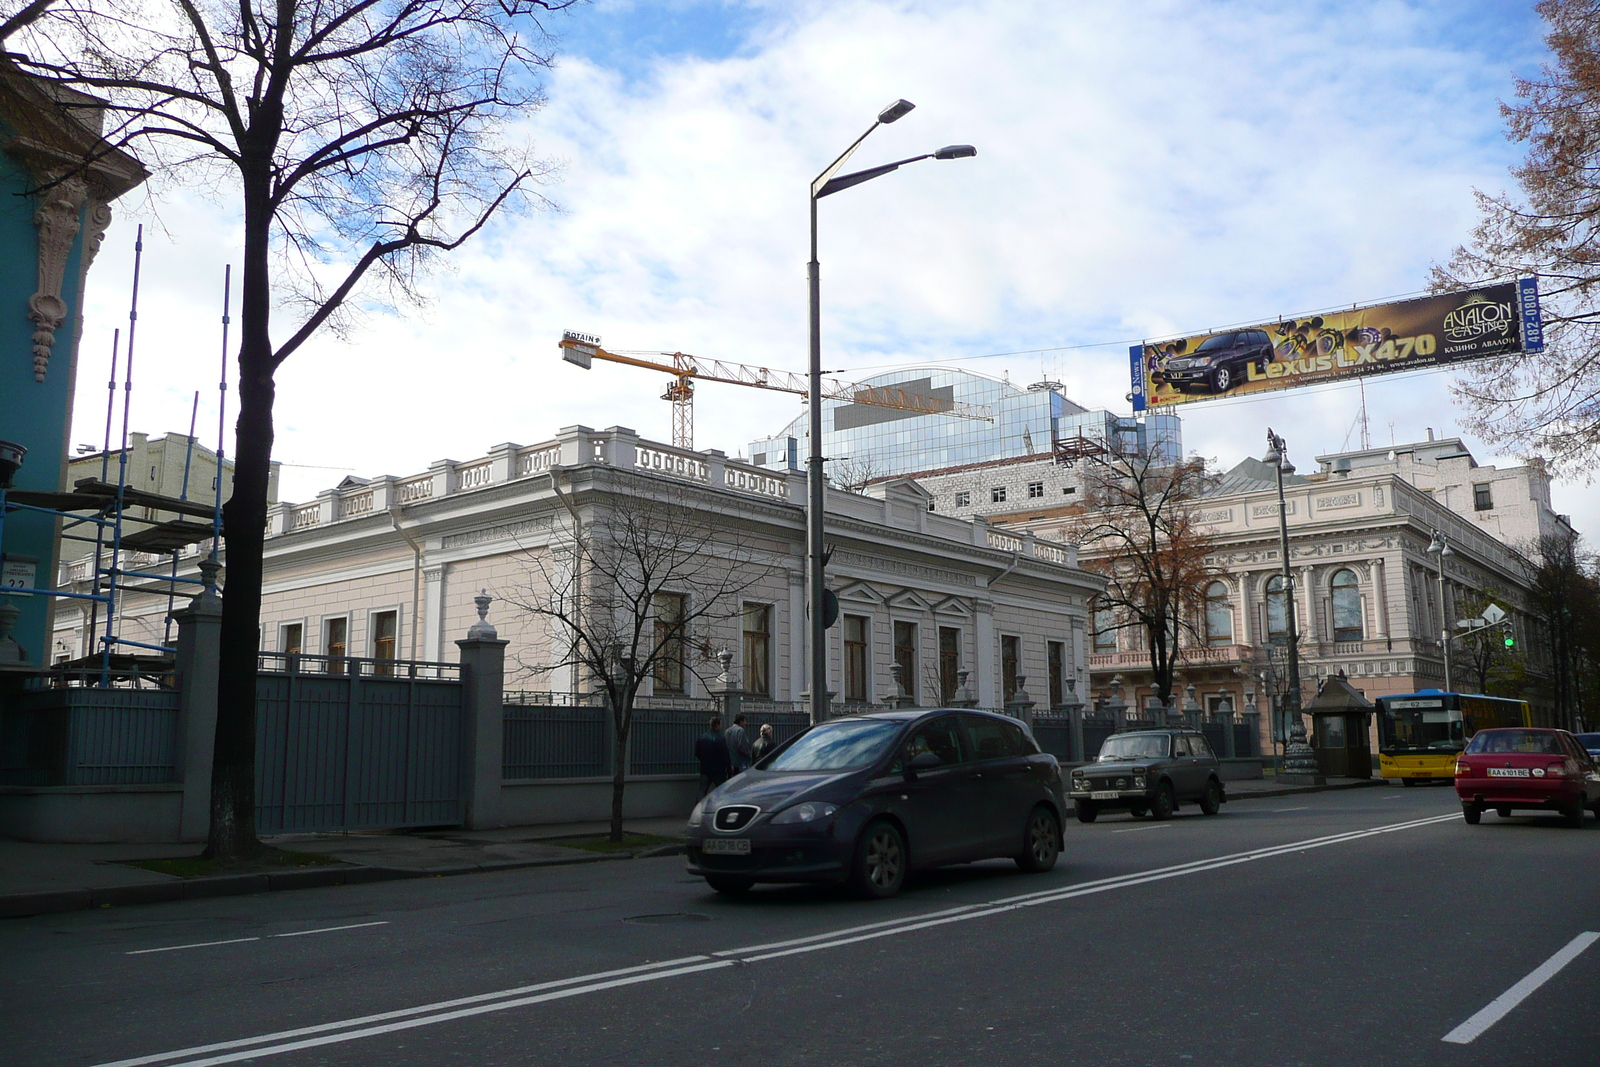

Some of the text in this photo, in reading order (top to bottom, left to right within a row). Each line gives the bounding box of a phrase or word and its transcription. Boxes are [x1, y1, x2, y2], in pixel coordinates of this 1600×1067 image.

[1443, 302, 1512, 329] AVALON
[1522, 287, 1541, 343] 482-0808
[1452, 319, 1509, 337] CASINO
[1444, 342, 1477, 354] КАЗИНО
[1481, 336, 1515, 348] АВАЛОН
[1246, 333, 1437, 382] Lexus LX470
[1133, 361, 1141, 384] News
[1353, 366, 1365, 375] 234
[1367, 365, 1375, 373] 74
[1502, 769, 1517, 777] 6101
